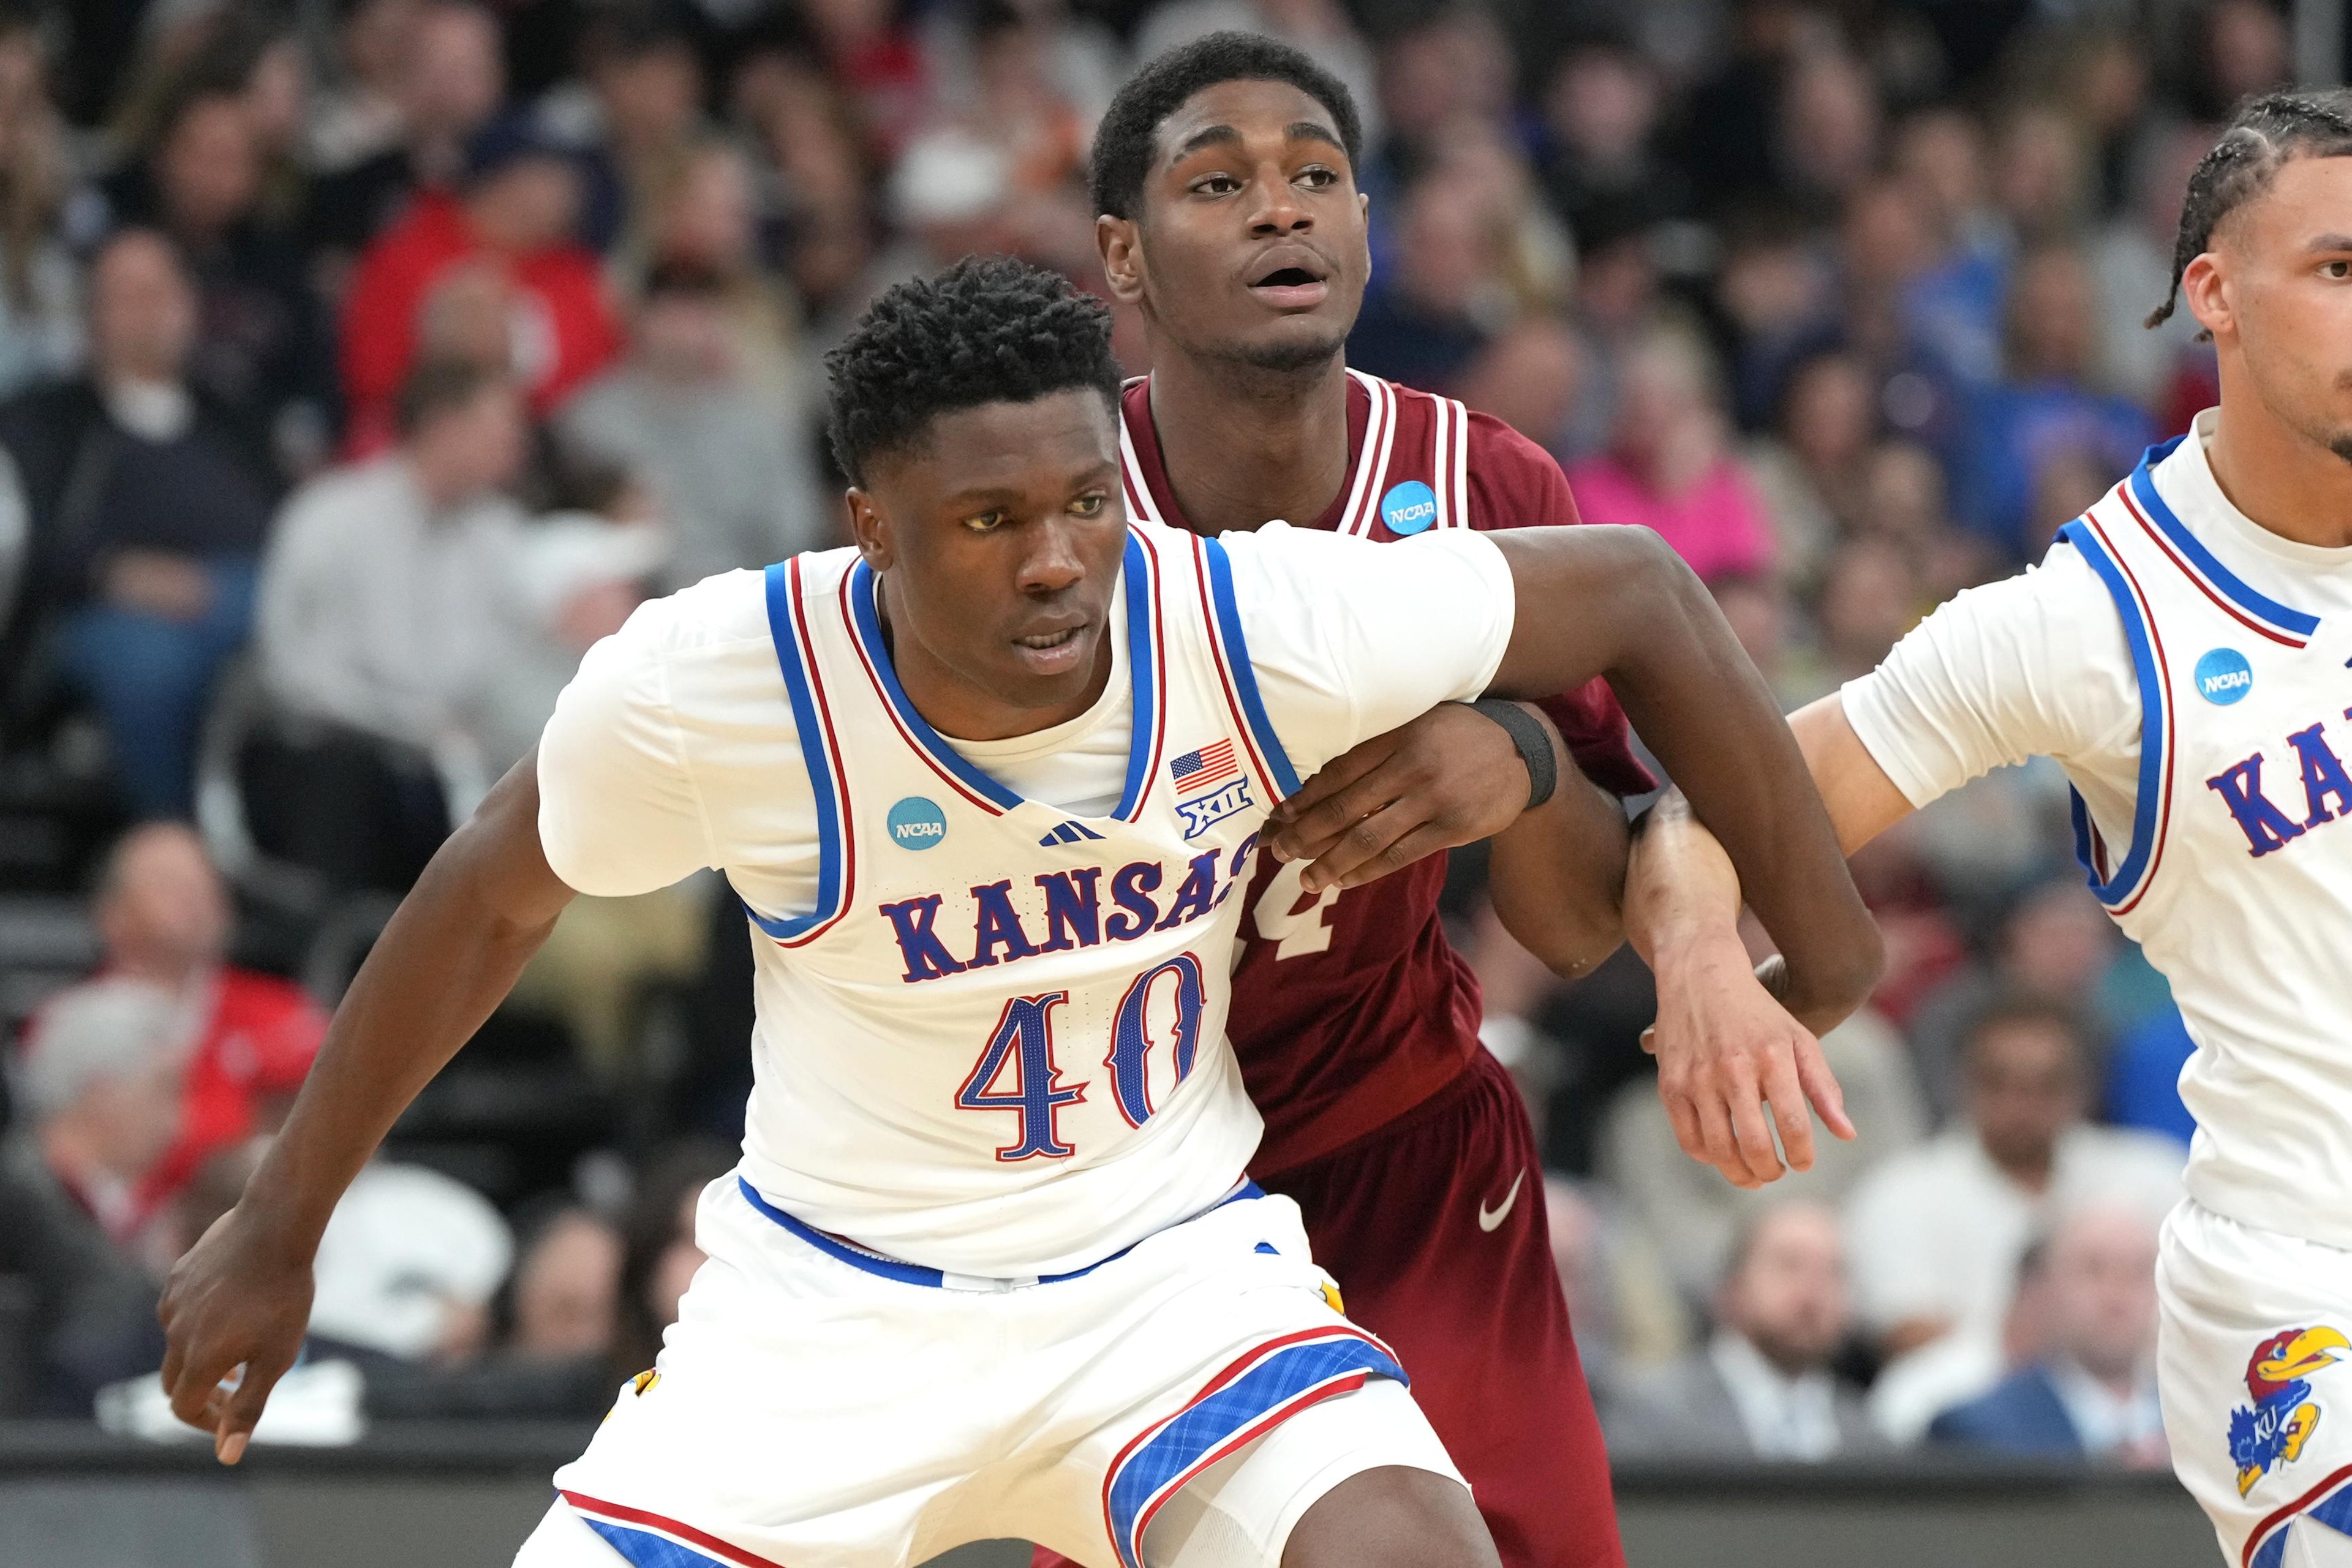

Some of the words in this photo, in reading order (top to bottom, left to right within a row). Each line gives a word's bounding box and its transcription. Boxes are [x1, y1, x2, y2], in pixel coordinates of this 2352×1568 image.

[1390, 501, 1434, 526] NCAA
[2204, 669, 2251, 693] NCAA
[2206, 707, 2352, 858] KA
[896, 823, 943, 839] NCAA
[954, 951, 1207, 1161] 40
[2253, 1405, 2277, 1445] KU
